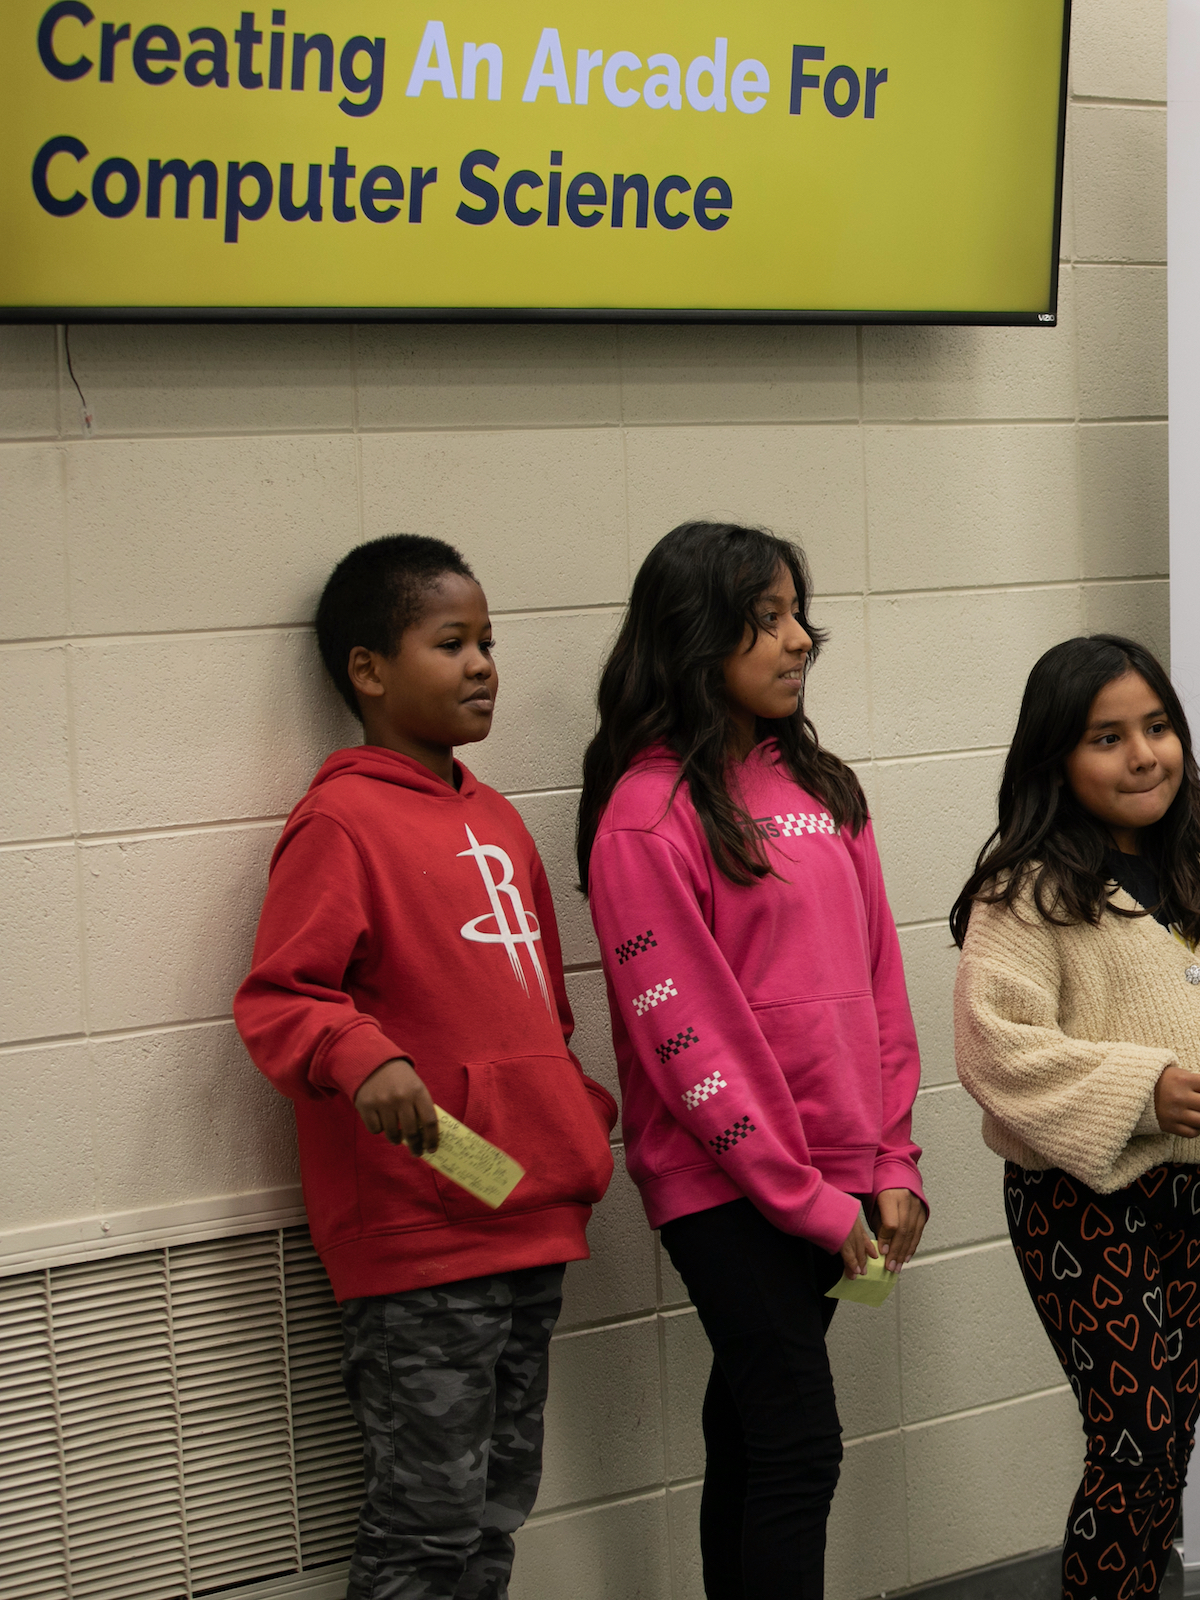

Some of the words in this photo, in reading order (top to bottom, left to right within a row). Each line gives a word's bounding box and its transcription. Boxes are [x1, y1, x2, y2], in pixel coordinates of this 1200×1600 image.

[37, 0, 386, 117] Creating
[406, 20, 503, 101] An
[522, 27, 770, 114] Arcade
[789, 44, 888, 119] For
[31, 134, 438, 244] Computer
[455, 148, 733, 231] Science
